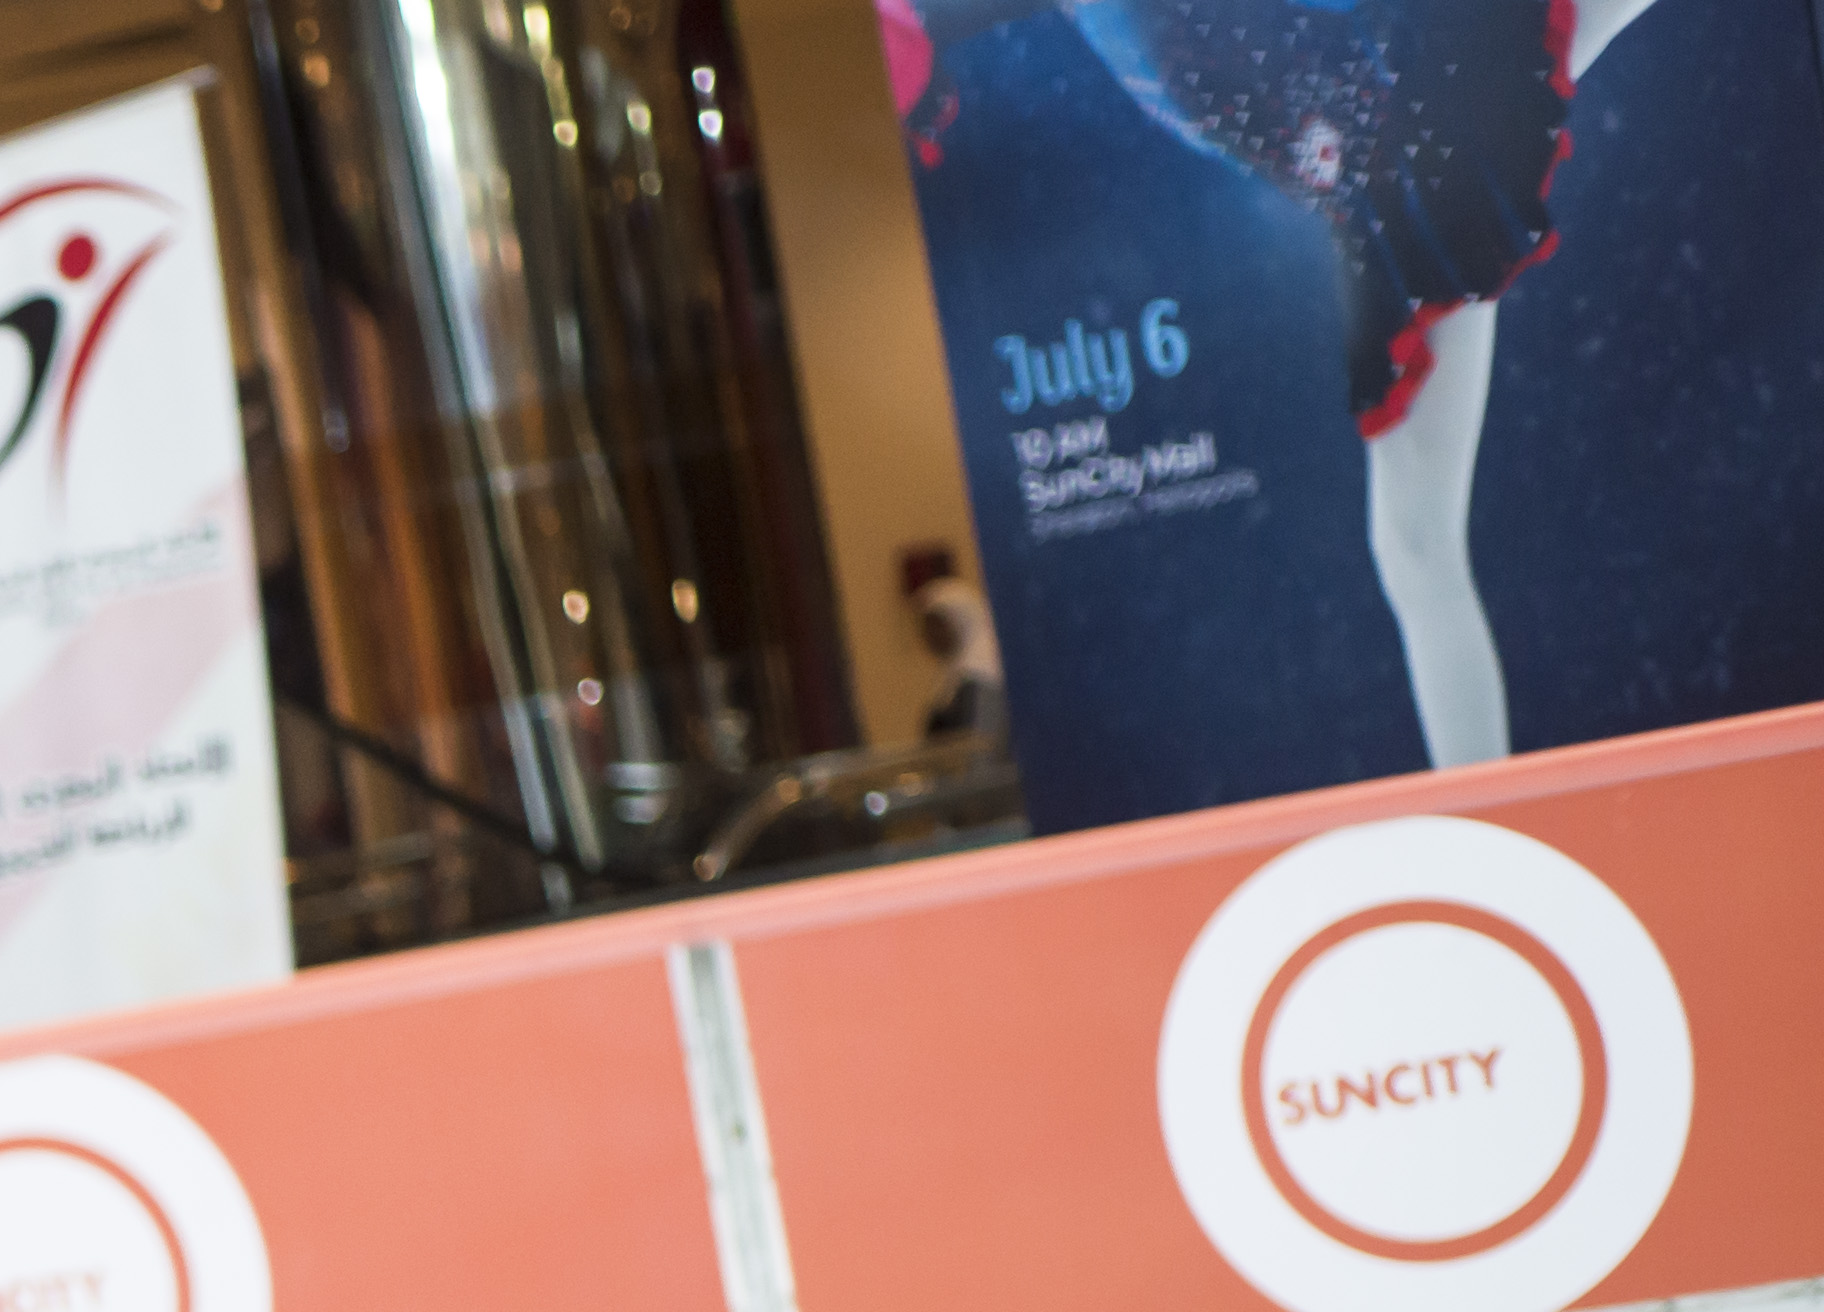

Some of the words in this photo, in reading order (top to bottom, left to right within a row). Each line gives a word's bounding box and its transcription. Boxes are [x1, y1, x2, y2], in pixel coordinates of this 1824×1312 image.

[993, 318, 1135, 413] July
[1139, 298, 1190, 378] 6
[1277, 1046, 1504, 1126] SUNCITY
